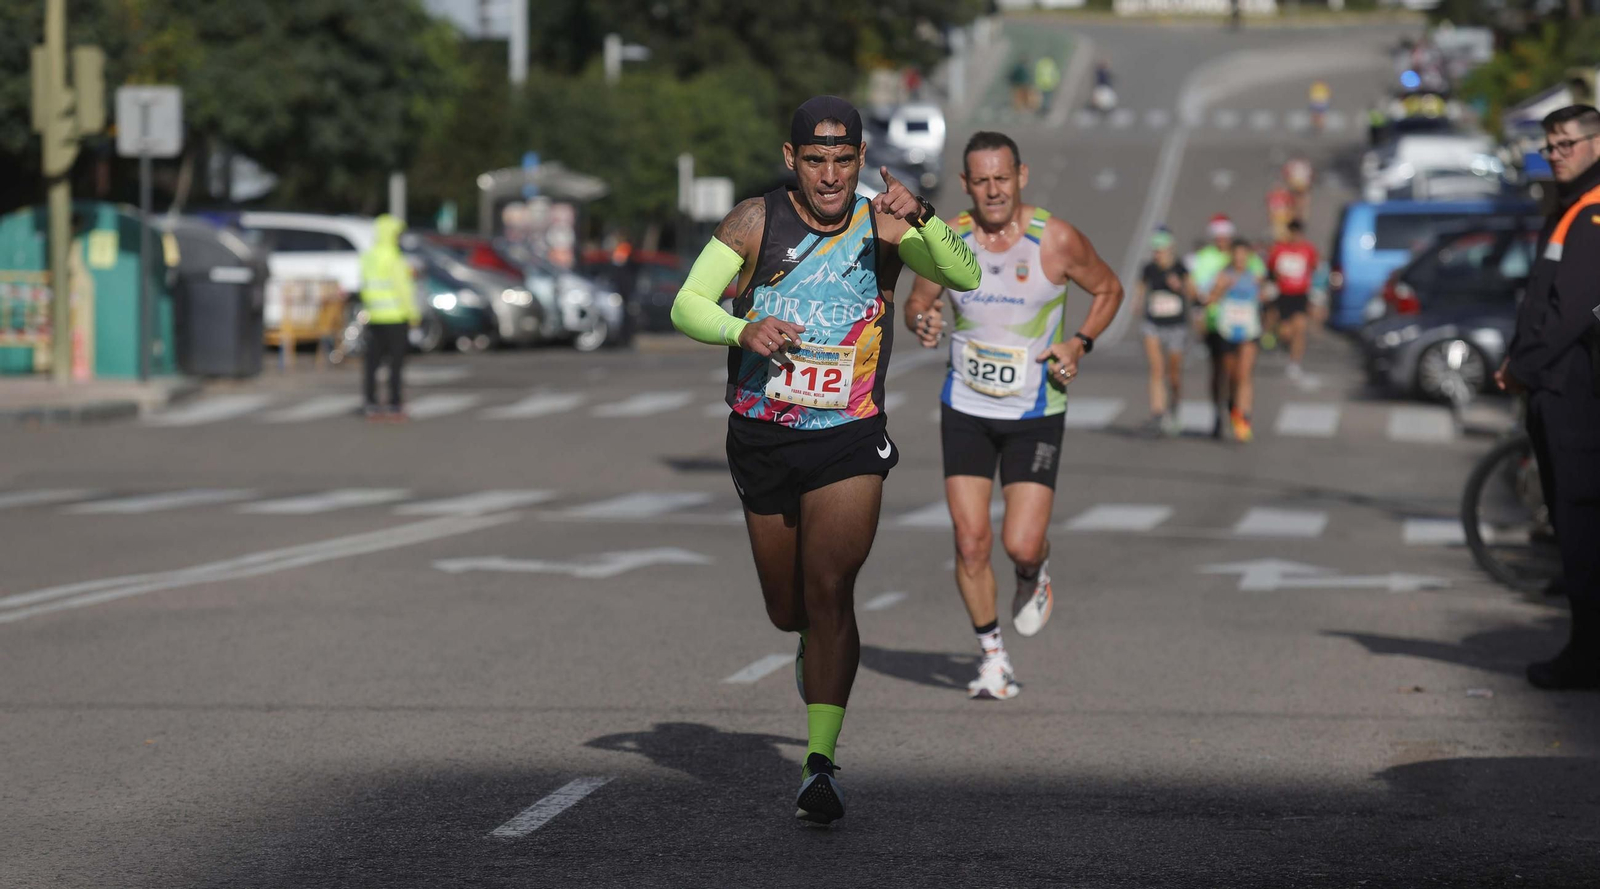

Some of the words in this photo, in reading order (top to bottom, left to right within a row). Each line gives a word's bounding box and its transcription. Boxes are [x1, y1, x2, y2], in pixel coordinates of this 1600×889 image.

[754, 291, 880, 327] CORRUCO
[960, 291, 1025, 305] Chipiona
[802, 328, 832, 338] EAM
[784, 366, 843, 393] 112
[967, 358, 1016, 384] 320
[771, 410, 835, 429] TOMAX
